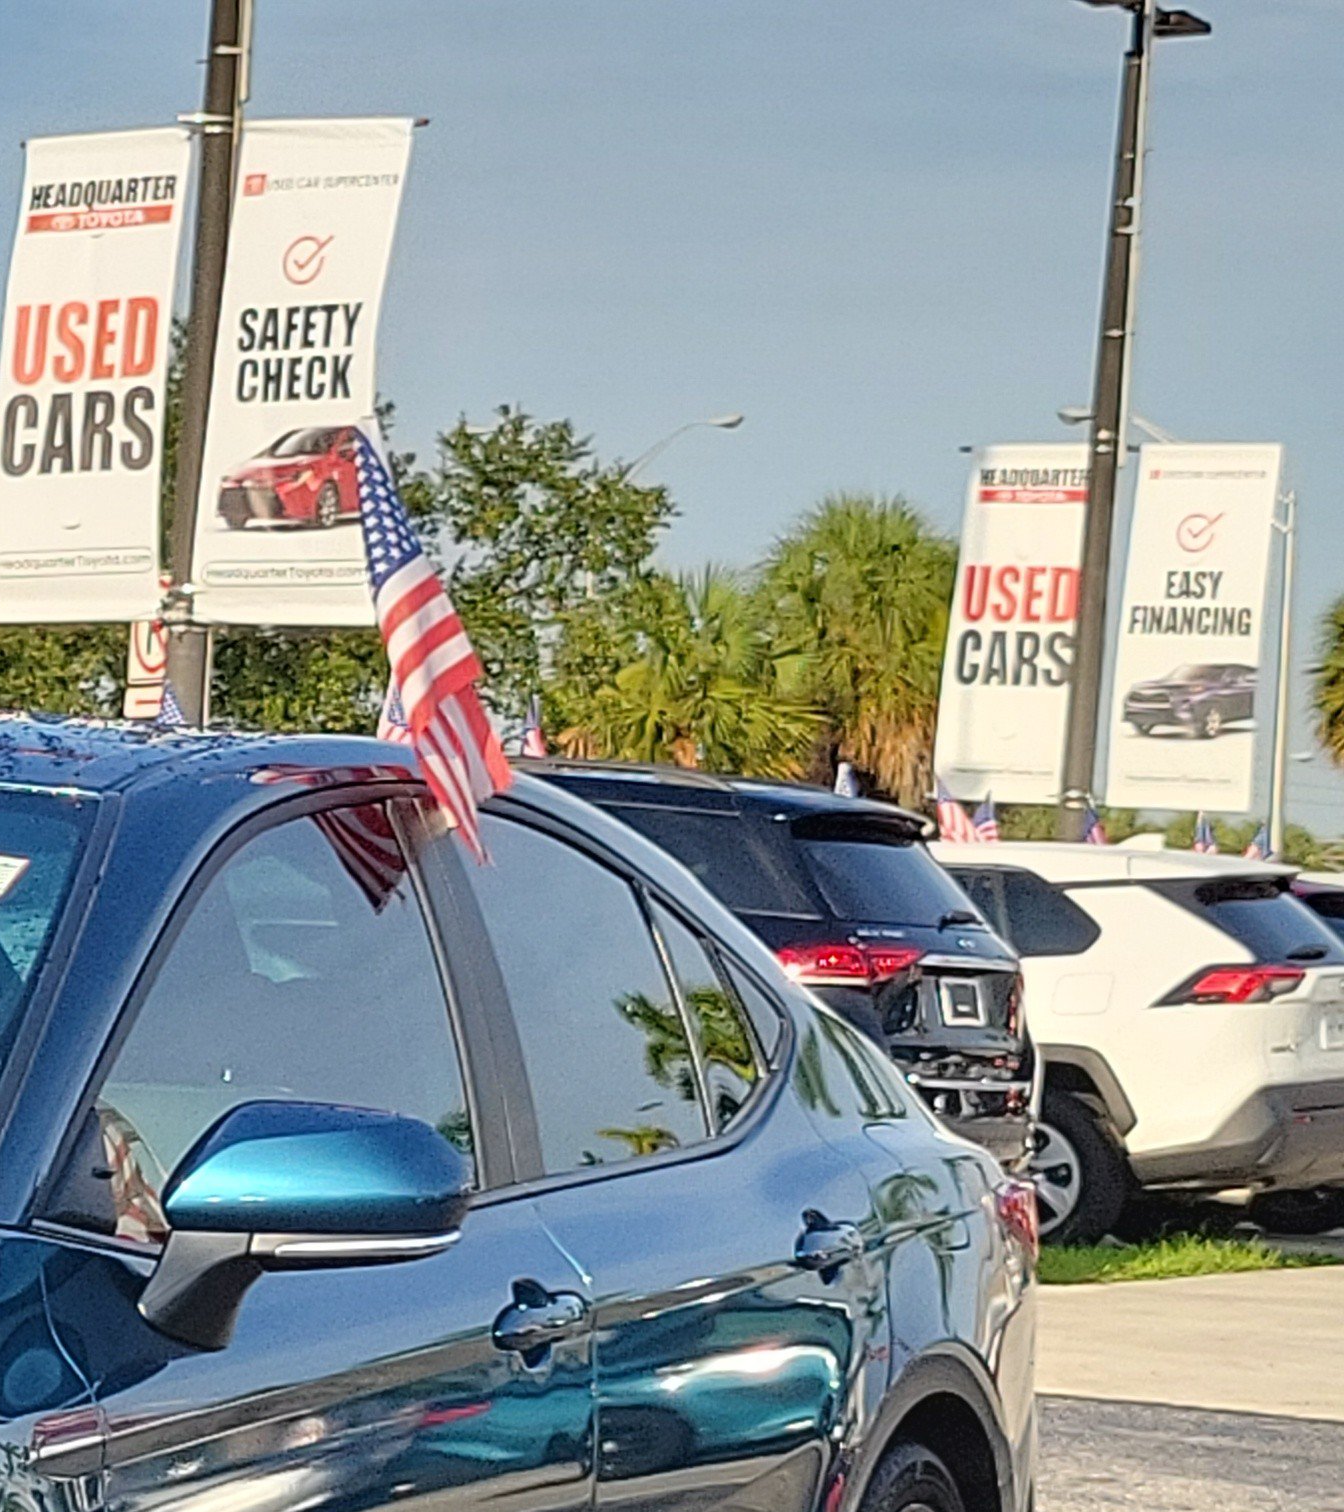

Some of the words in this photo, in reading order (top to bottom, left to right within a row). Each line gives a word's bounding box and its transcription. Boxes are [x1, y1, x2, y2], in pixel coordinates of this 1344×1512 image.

[29, 174, 177, 211] HEADQUARTER
[78, 210, 145, 229] TOYOTA
[13, 296, 159, 386] USED
[237, 302, 363, 352] SAFETY
[236, 354, 353, 402] CHECK
[1, 386, 155, 476] CARS
[963, 565, 1079, 623] USED
[1165, 570, 1223, 600] EASY
[1127, 605, 1252, 636] FINANCING
[956, 629, 1077, 686] CARS
